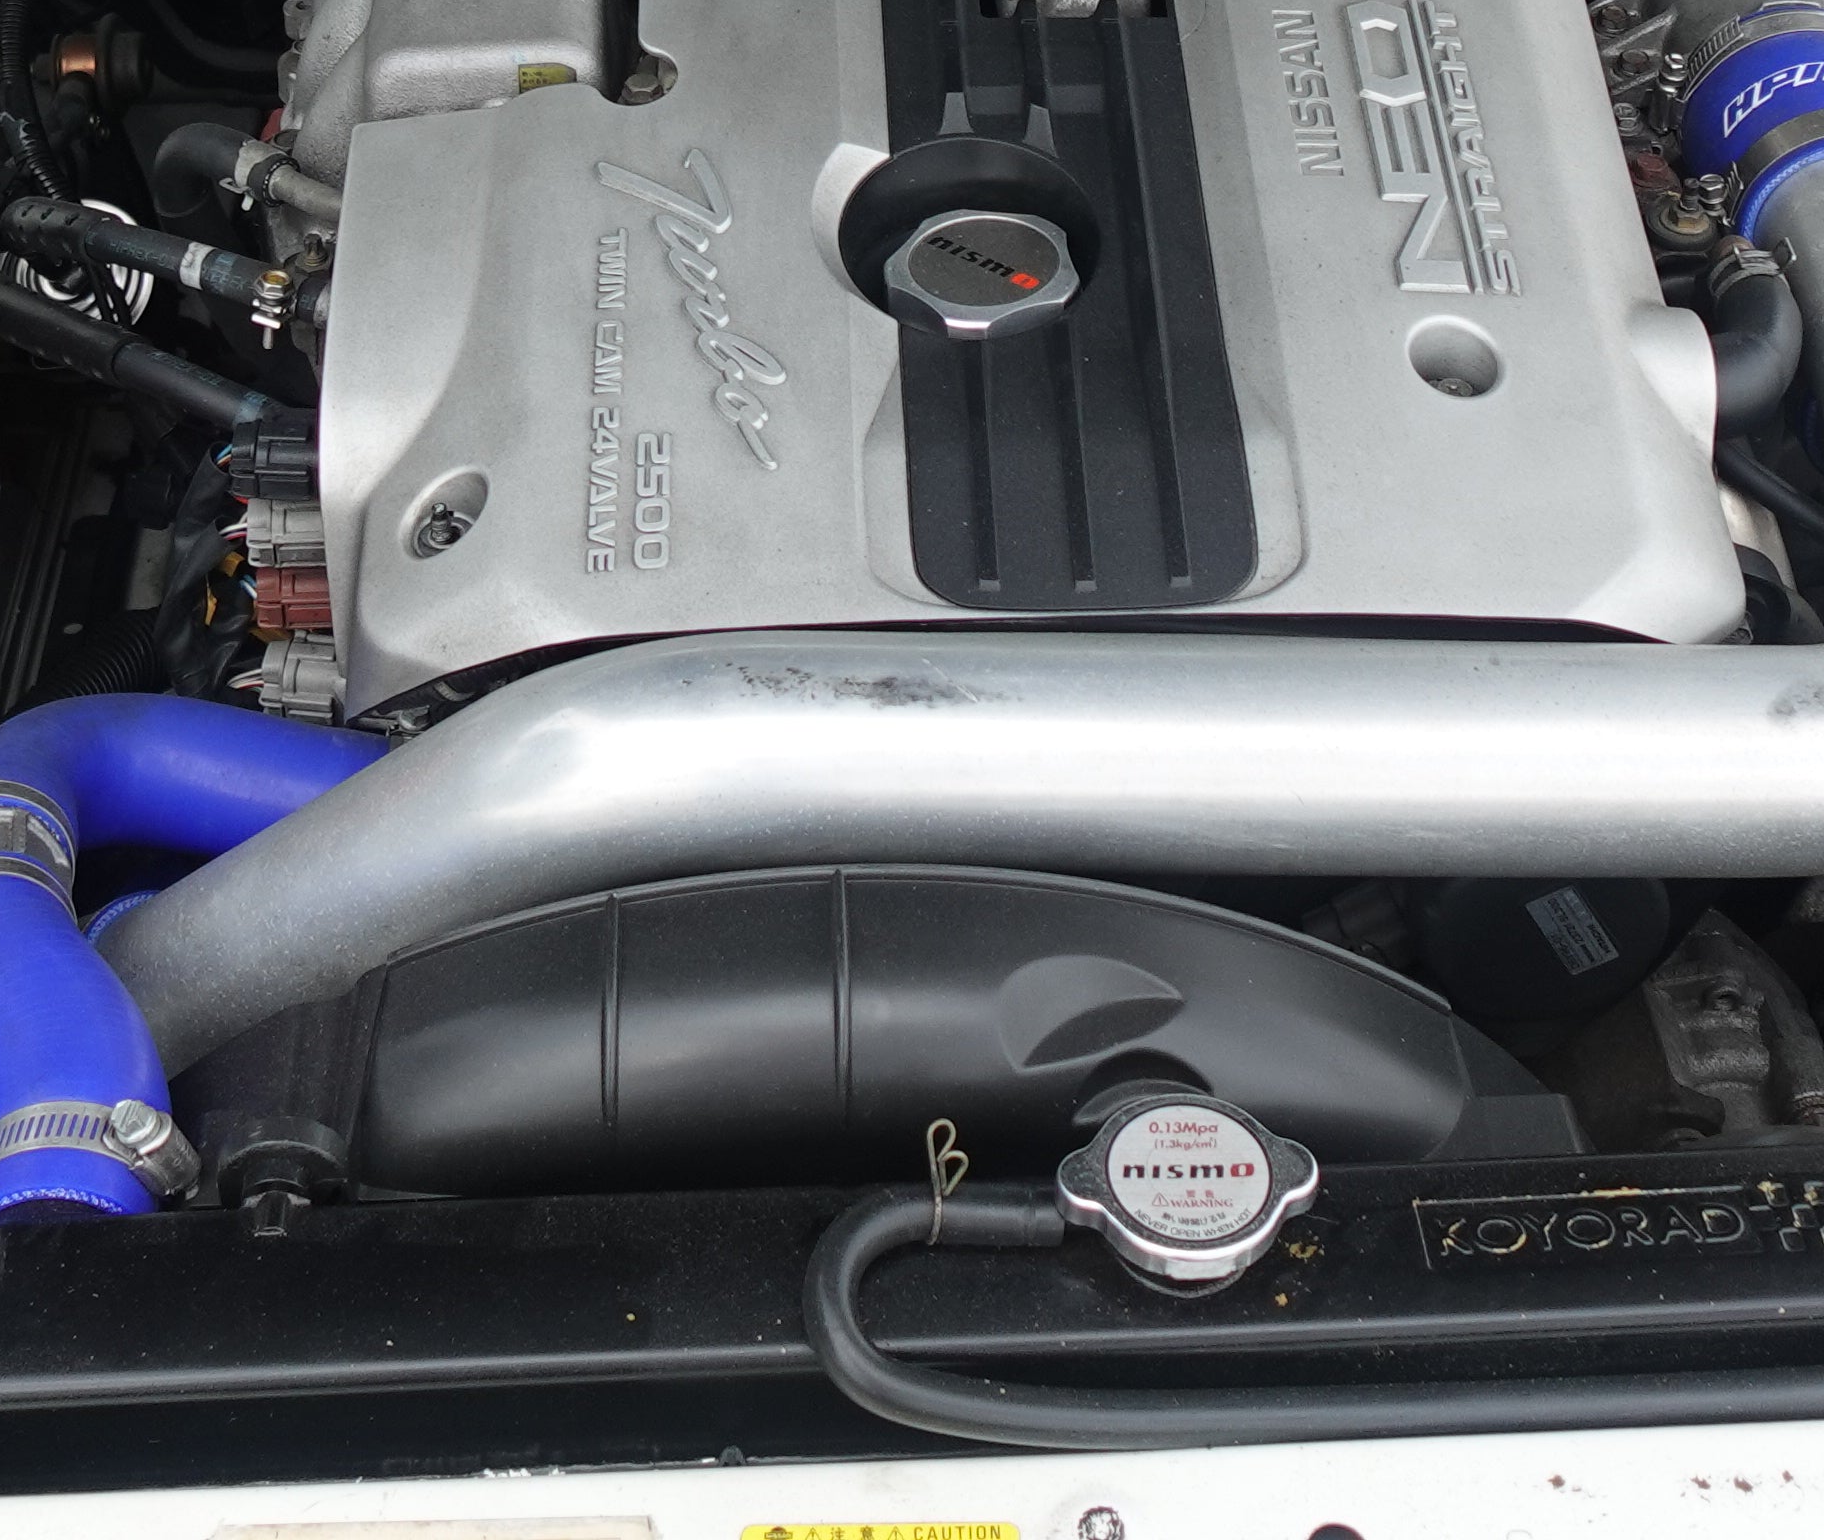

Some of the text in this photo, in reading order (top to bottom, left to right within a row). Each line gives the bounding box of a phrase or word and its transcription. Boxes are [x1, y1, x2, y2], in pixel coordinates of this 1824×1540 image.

[1271, 9, 1345, 177] NISSAN
[1723, 61, 1824, 139] HPI
[1423, 0, 1521, 297] STRAIGHT
[927, 236, 1040, 290] nismo
[594, 148, 788, 471] Turbo
[585, 226, 629, 574] TWIN CAM 24VALVE
[634, 431, 672, 570] 2500
[1149, 1121, 1218, 1136] 0.13Mpa
[1123, 1162, 1255, 1178] nismo
[1134, 1207, 1253, 1238] NEVER OPEN WHEN HOT
[1169, 1198, 1234, 1208] WARNING
[1438, 1202, 1746, 1256] KOYORAD
[913, 1525, 1001, 1540] CAUTION
